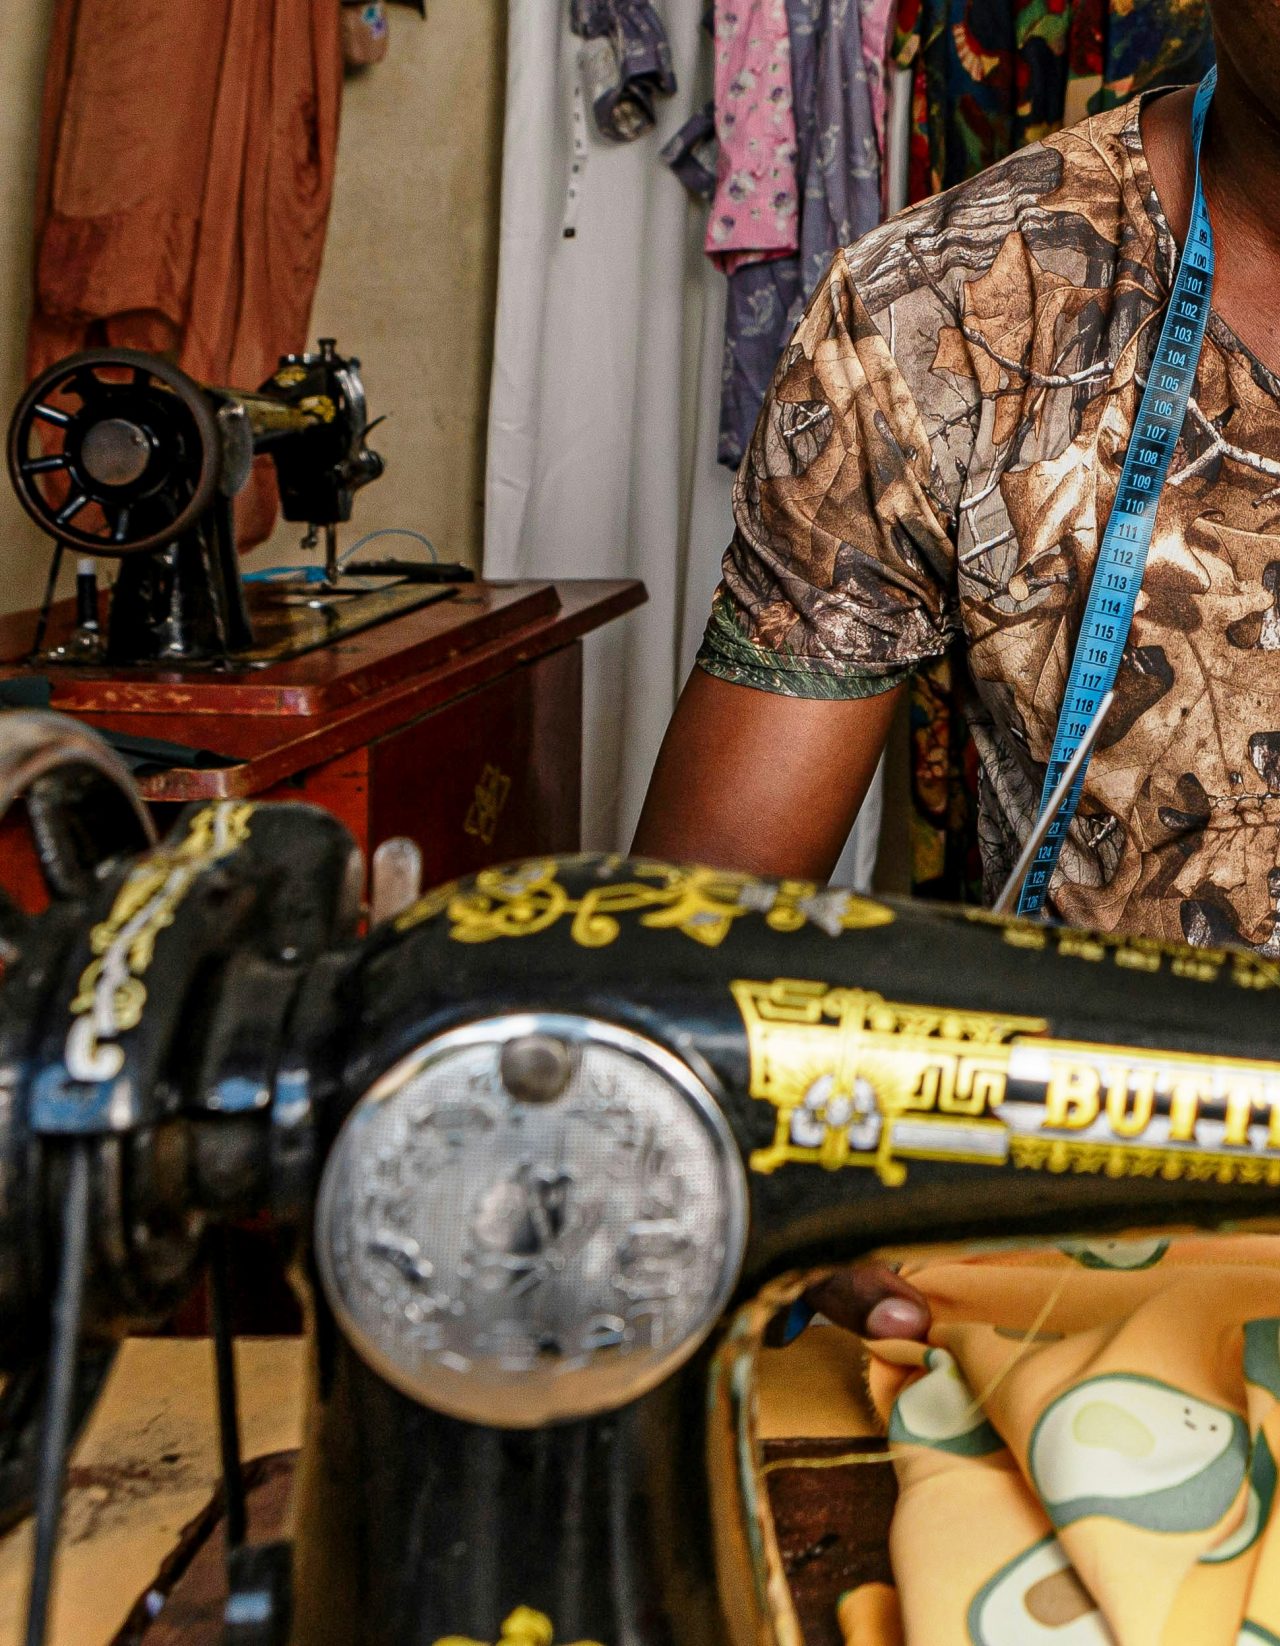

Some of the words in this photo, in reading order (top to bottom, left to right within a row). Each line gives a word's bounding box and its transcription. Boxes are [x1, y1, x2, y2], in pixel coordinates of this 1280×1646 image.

[1193, 253, 1207, 269] 100
[1187, 276, 1203, 294] 101
[1180, 301, 1198, 318] 102
[1174, 325, 1192, 342] 103
[1167, 350, 1186, 367] 104
[1160, 375, 1179, 392] 105
[1153, 399, 1173, 416] 106
[1146, 424, 1167, 440] 107
[1139, 449, 1158, 465] 108
[1132, 473, 1151, 490] 109
[1125, 498, 1144, 514] 110
[1119, 523, 1138, 539] 111
[1113, 548, 1133, 565] 112
[1107, 573, 1127, 590] 113
[1101, 598, 1120, 614] 114
[1095, 623, 1115, 639] 115
[1088, 648, 1108, 664] 116
[1082, 673, 1101, 688] 117
[1076, 698, 1093, 712] 118
[1069, 723, 1086, 737] 119
[1063, 748, 1077, 761] 12
[1048, 822, 1060, 834] 23
[1038, 846, 1053, 859] 124
[1032, 871, 1045, 884] 125
